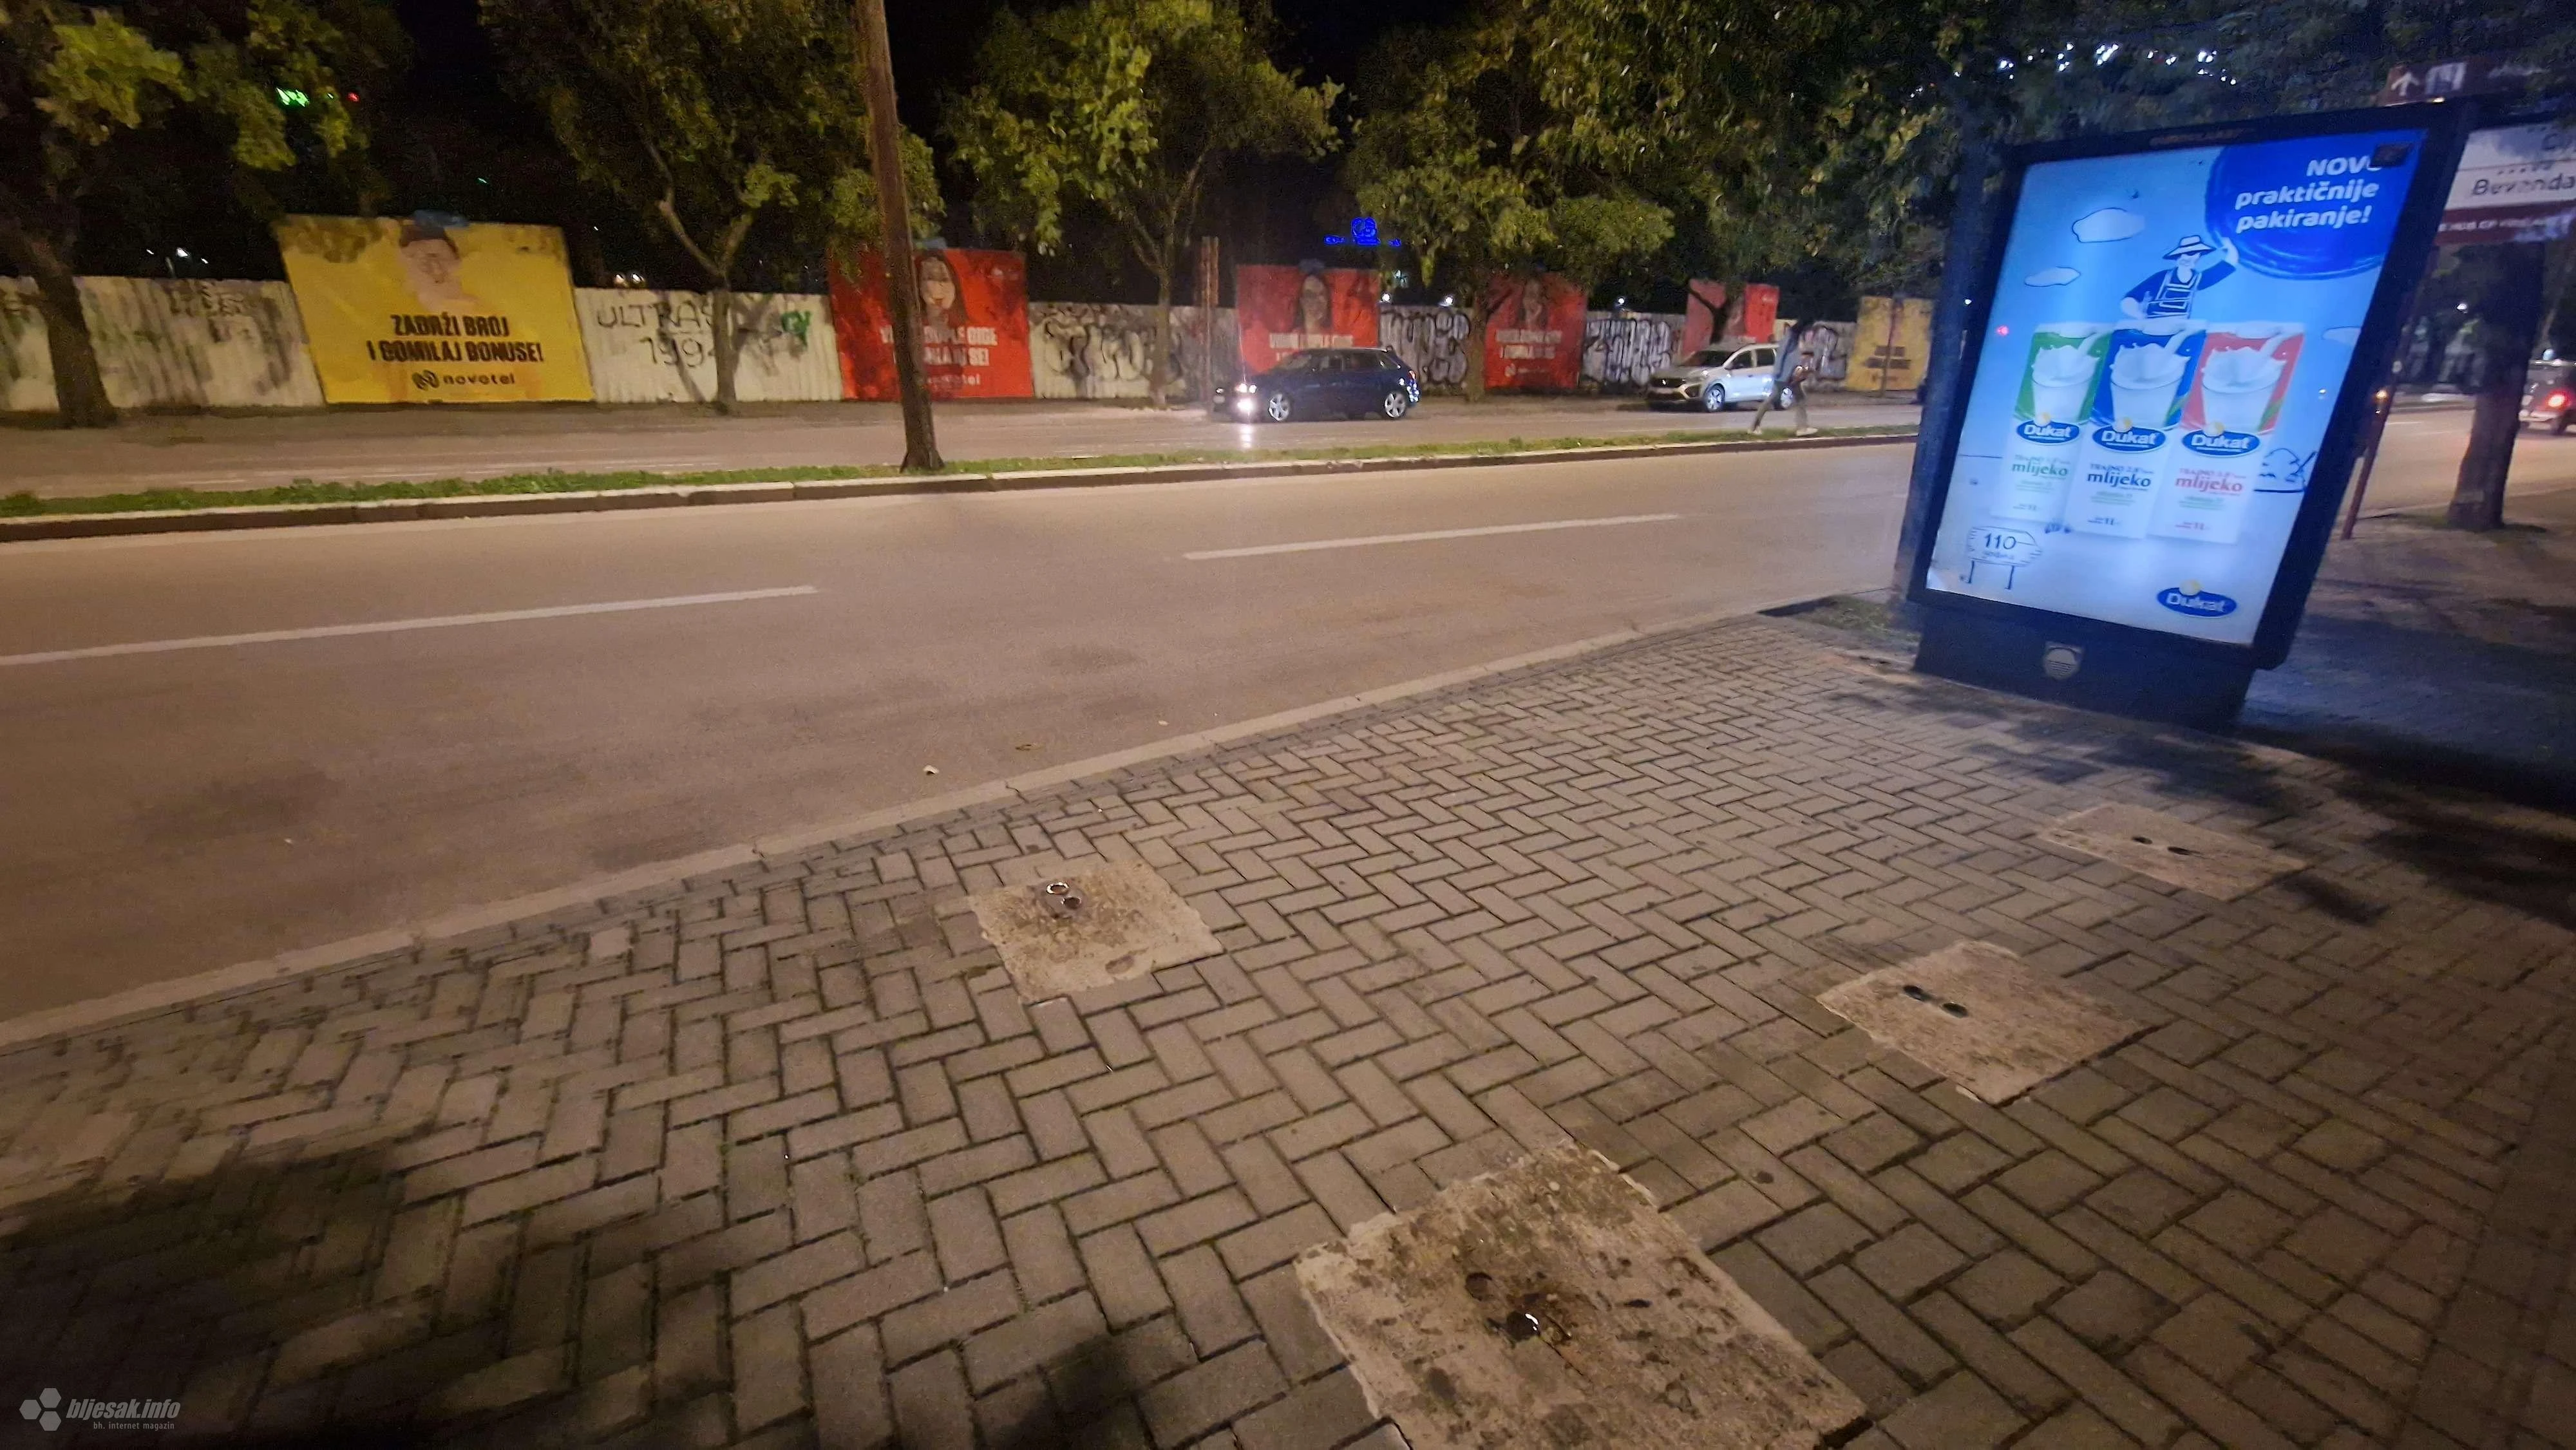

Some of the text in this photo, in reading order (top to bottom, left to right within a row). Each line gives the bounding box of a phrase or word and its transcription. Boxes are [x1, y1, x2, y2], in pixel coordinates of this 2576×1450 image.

[2235, 178, 2380, 211] praktičnije
[2235, 205, 2372, 234] pakiranje!
[391, 312, 511, 337] ZADRŽI BROJ
[366, 340, 544, 362] I GOMILAJ BONUSE!
[443, 373, 515, 385] novotel
[2023, 424, 2072, 438] Dukat
[2101, 429, 2159, 445] Dukat
[2191, 434, 2250, 449] Dukat
[2011, 462, 2068, 477] mlijeko
[2087, 471, 2152, 487] mlijeko
[2175, 475, 2243, 492] mlijeko
[1984, 533, 2017, 550] 110
[2166, 592, 2226, 612] Dukat
